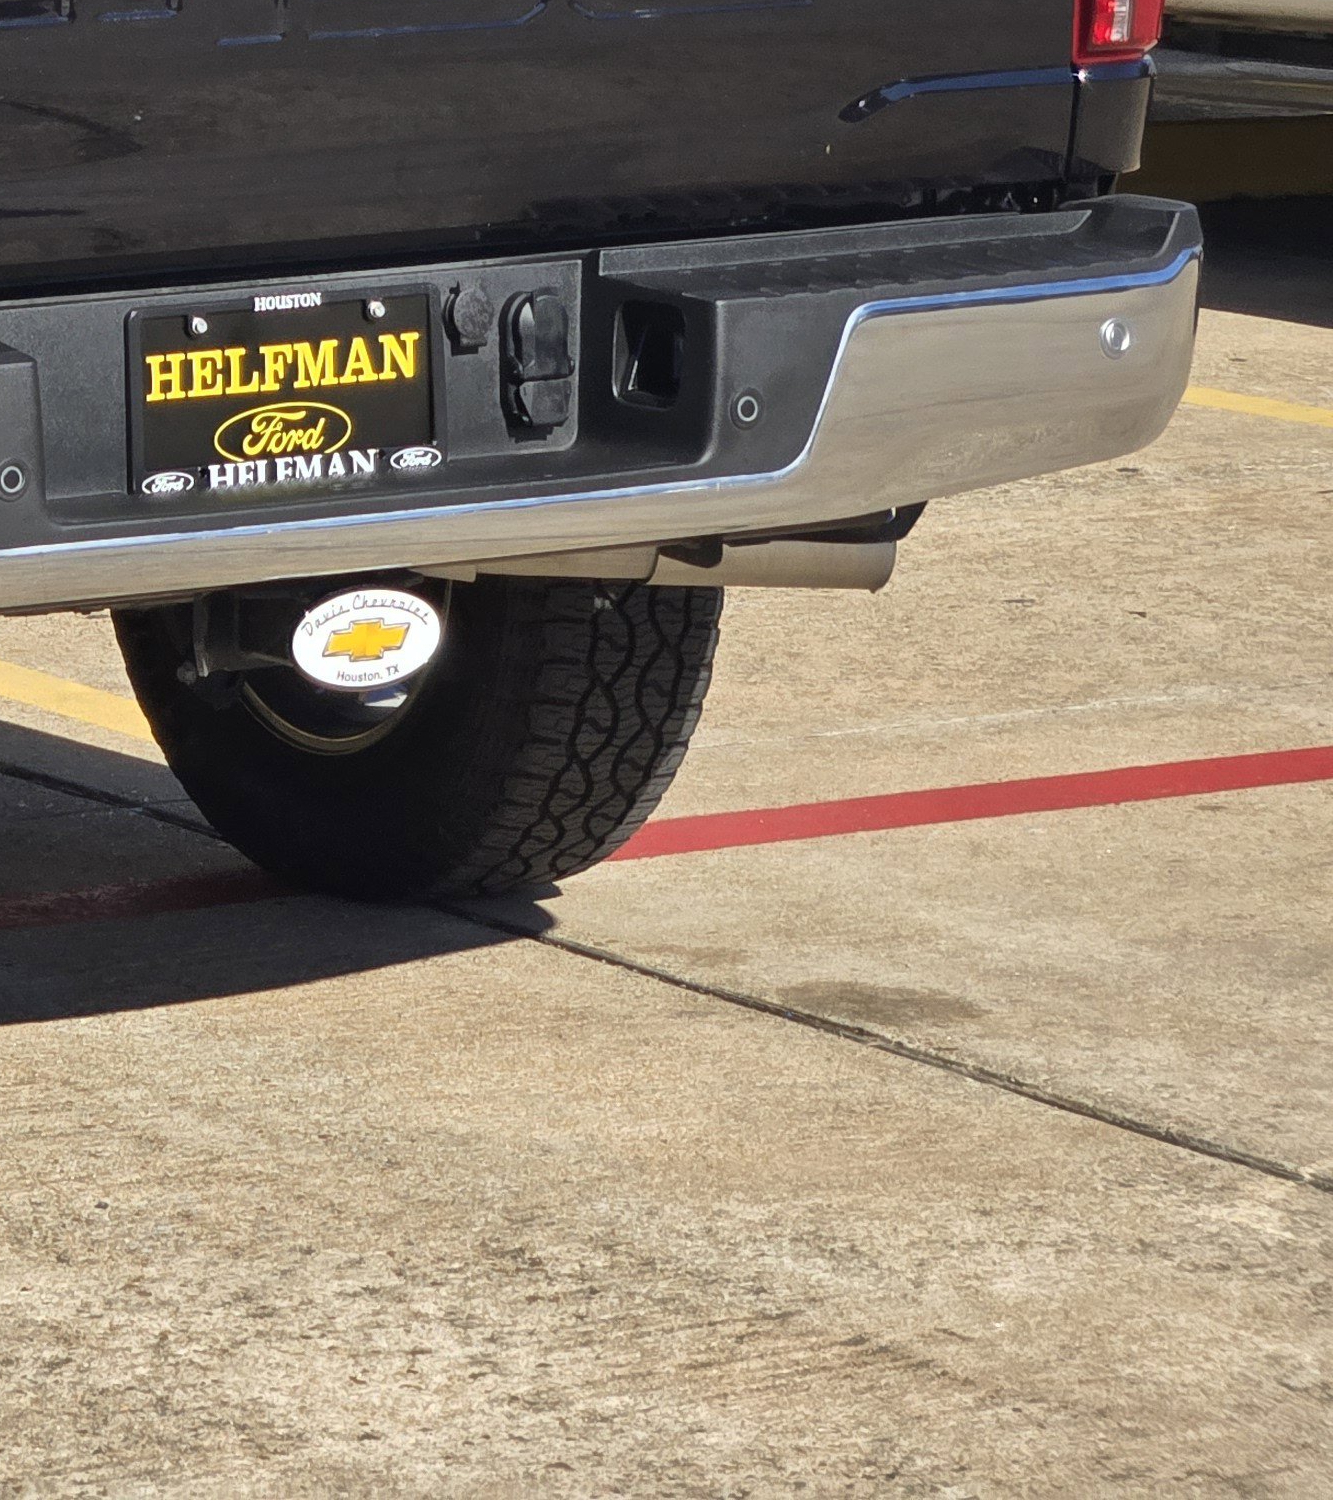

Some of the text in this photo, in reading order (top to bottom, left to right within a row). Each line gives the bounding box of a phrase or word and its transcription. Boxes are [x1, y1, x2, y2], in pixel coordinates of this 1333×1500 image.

[254, 293, 321, 312] HOUSTON
[146, 331, 420, 402] HELFMAN
[242, 410, 326, 456] Ford
[301, 604, 350, 636] Davis
[337, 664, 400, 682] Houston, TX
